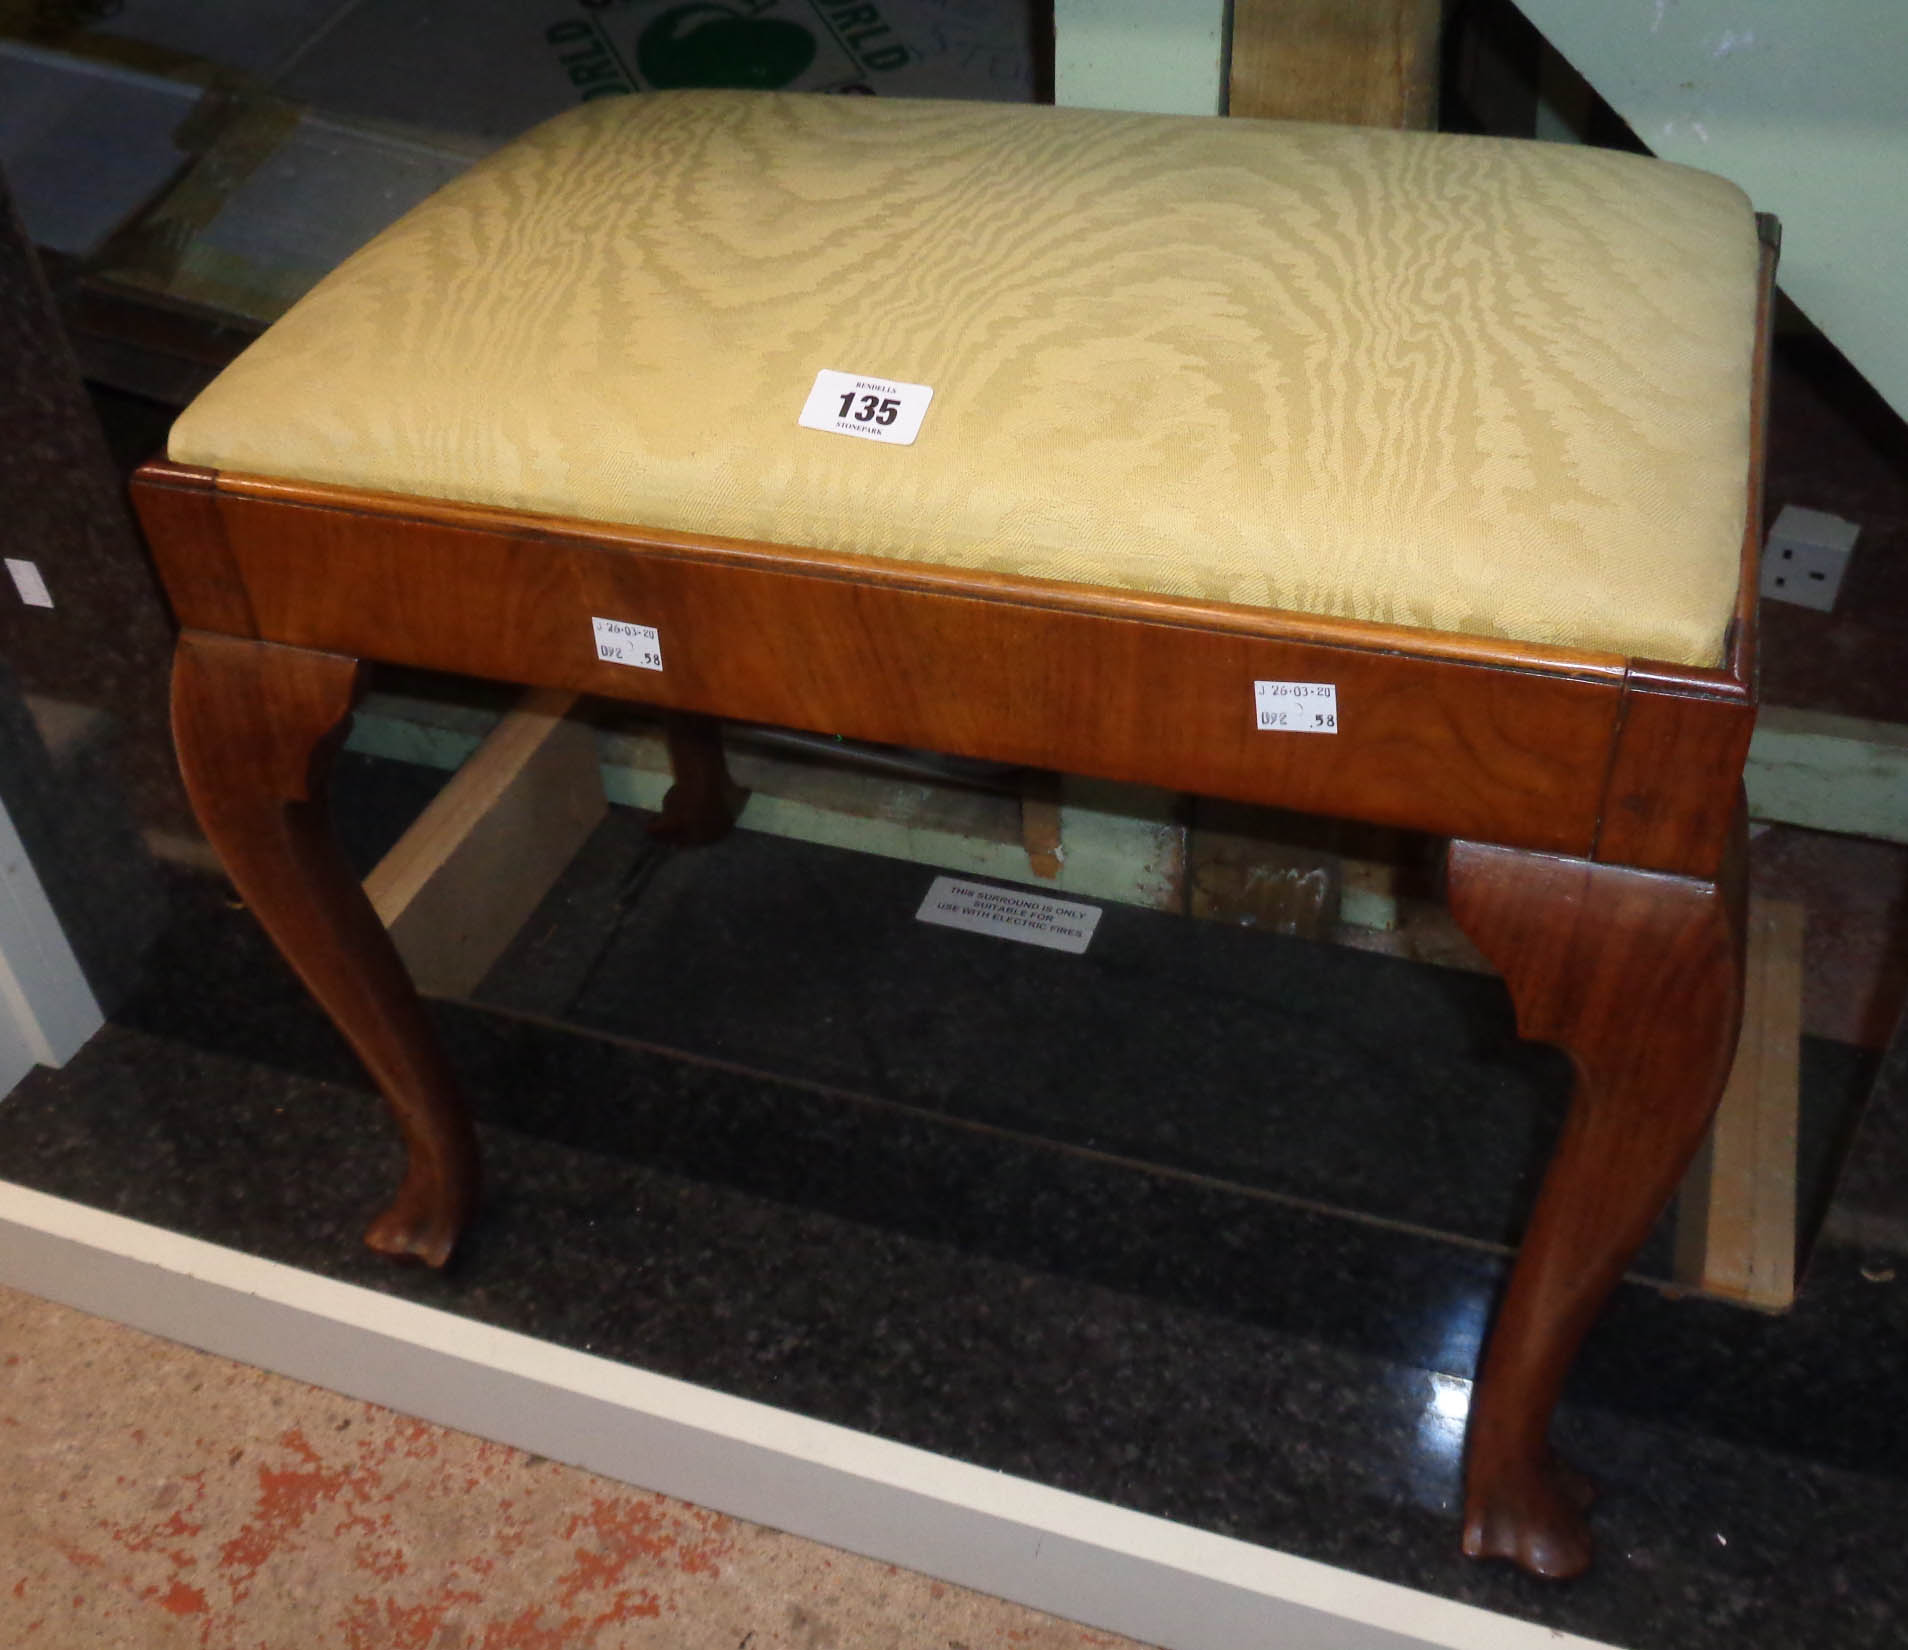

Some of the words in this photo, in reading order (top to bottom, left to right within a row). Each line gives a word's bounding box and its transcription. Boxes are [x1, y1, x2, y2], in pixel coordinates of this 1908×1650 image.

[856, 382, 896, 394] RENDELLS
[838, 392, 901, 426] 135
[836, 421, 882, 436] STONEPARK
[951, 887, 975, 897] THIS
[976, 892, 1039, 910] SURROUND
[1041, 905, 1053, 914] IS
[1055, 908, 1086, 919] ONLY
[973, 901, 1026, 917] SUITABLE
[1030, 911, 1054, 922] FOR
[937, 903, 958, 912] USE
[962, 907, 990, 918] WITH
[992, 914, 1047, 929] ELECTRIC
[1050, 926, 1083, 938] FIRES
